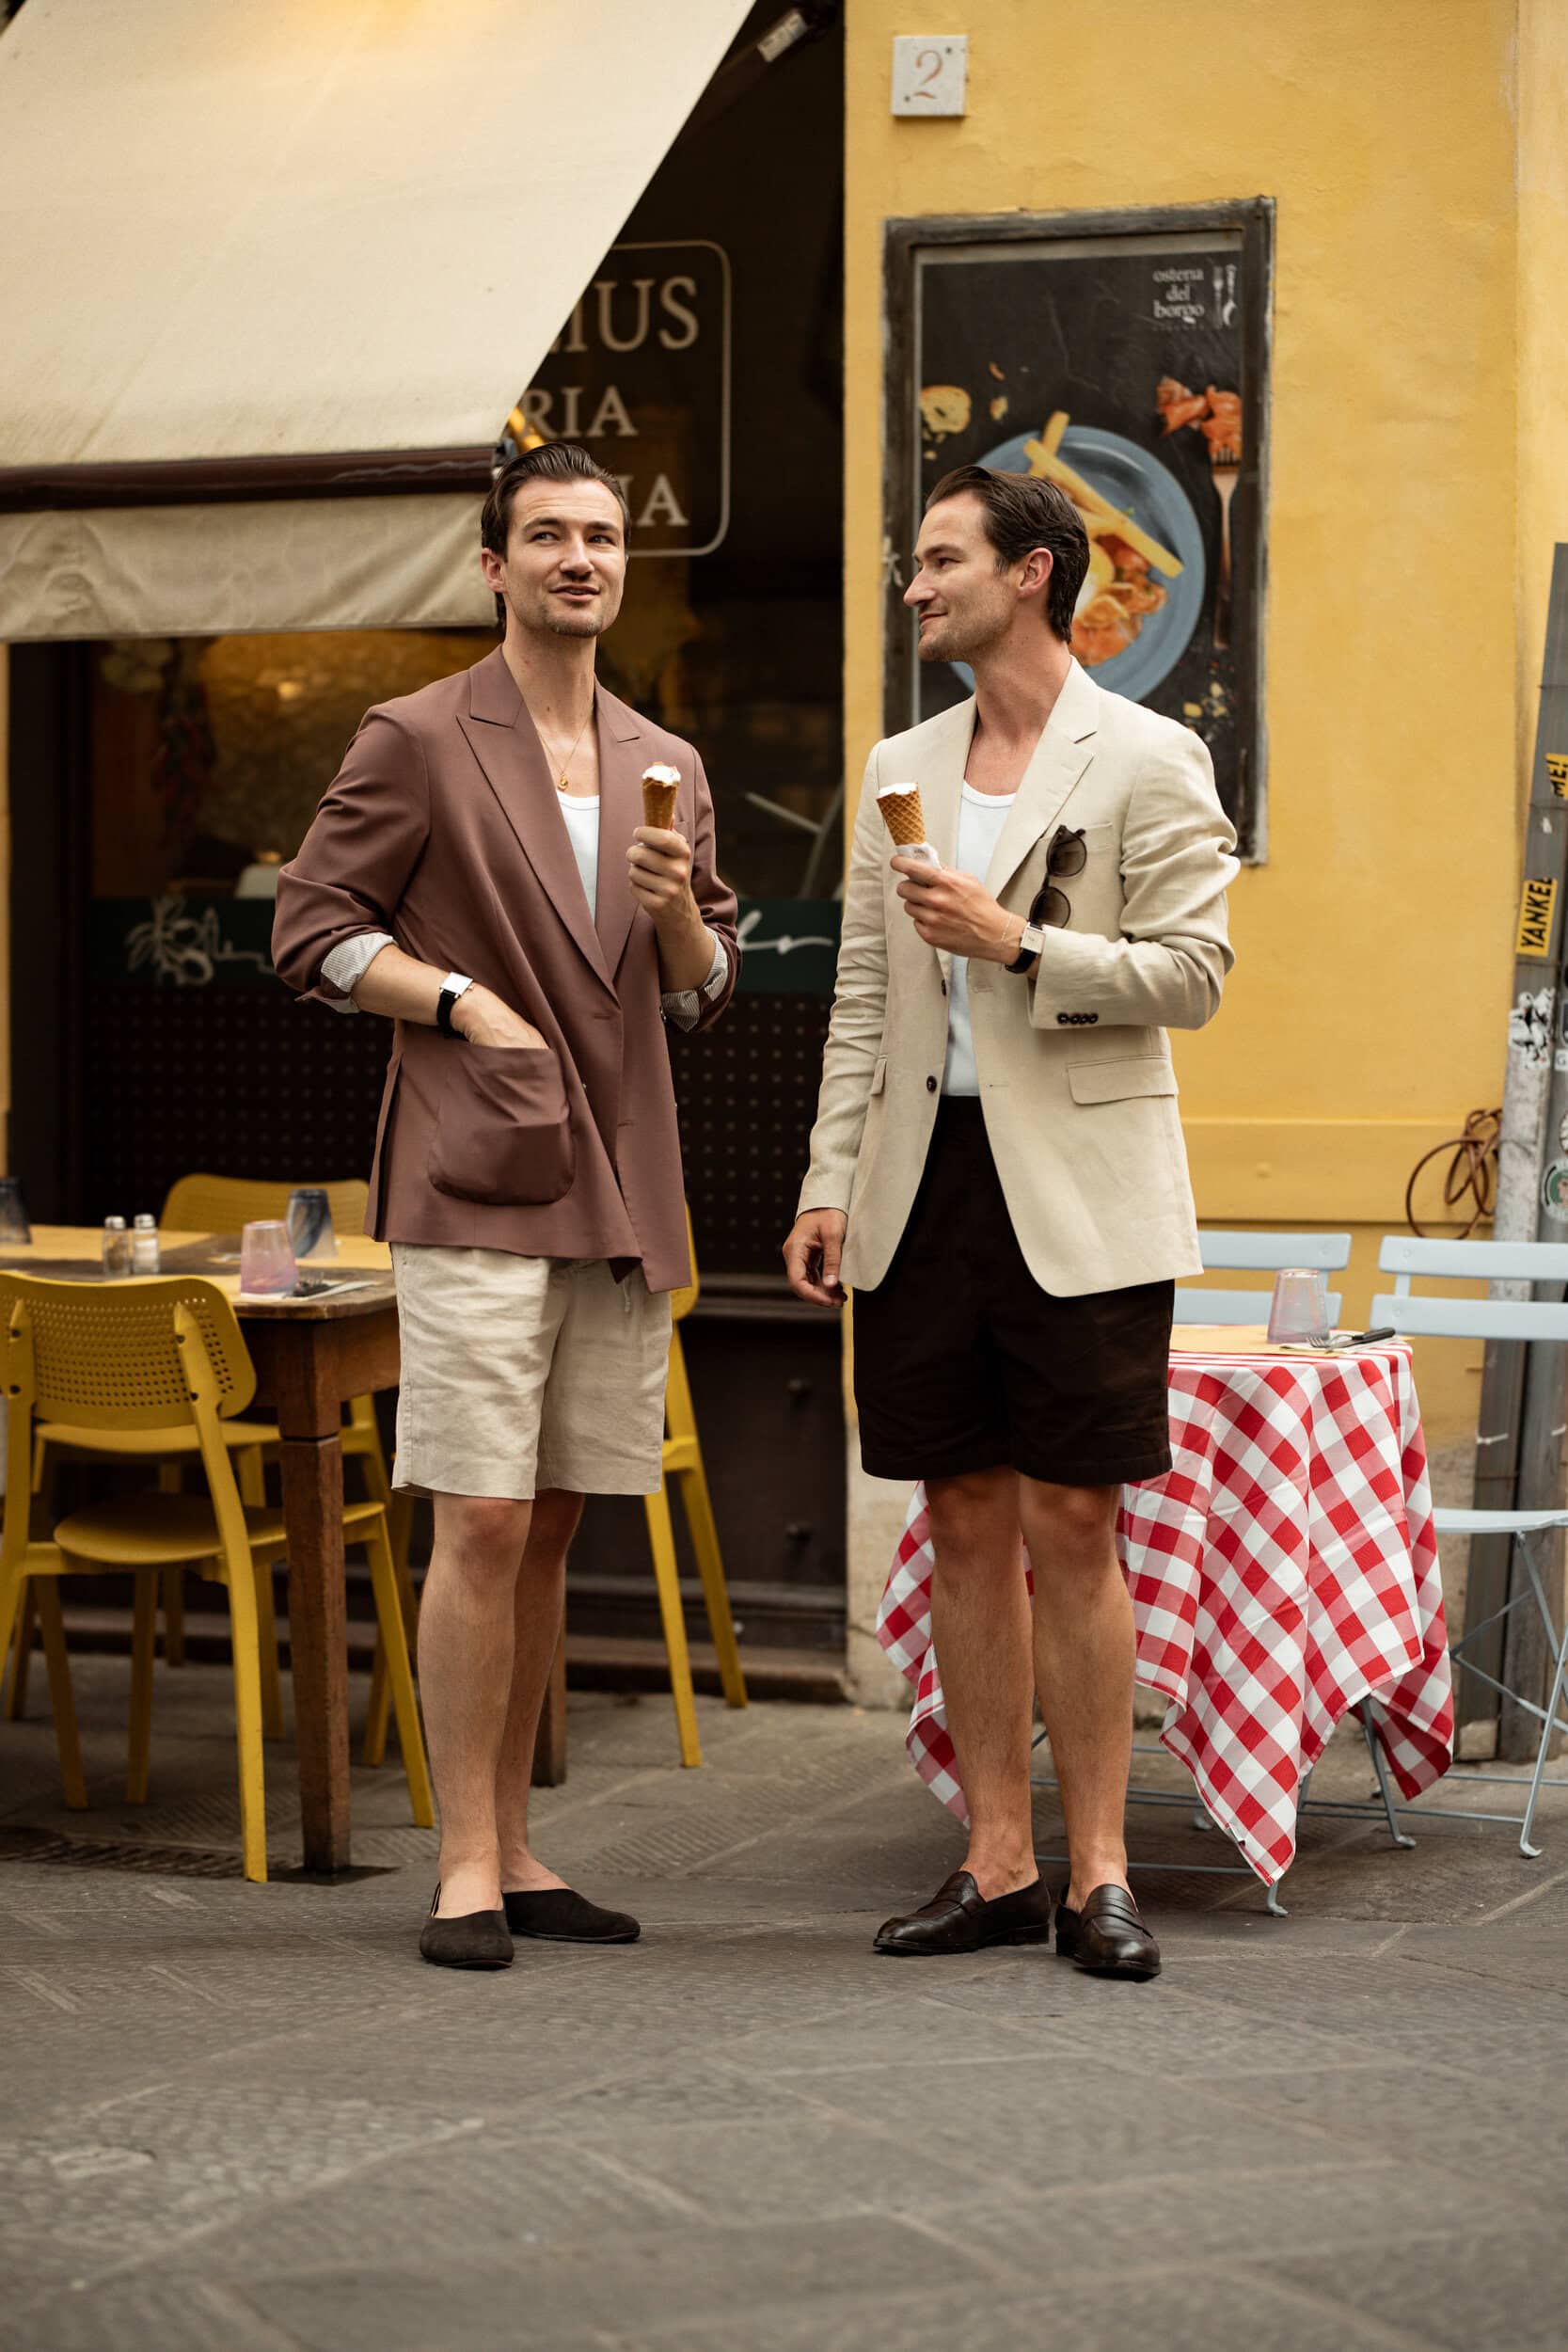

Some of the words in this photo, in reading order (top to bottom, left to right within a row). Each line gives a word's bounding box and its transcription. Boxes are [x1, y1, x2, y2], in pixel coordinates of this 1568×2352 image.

[912, 49, 943, 100] 2
[1165, 283, 1191, 301] del
[548, 275, 700, 354] IUS
[1153, 299, 1205, 324] borgo
